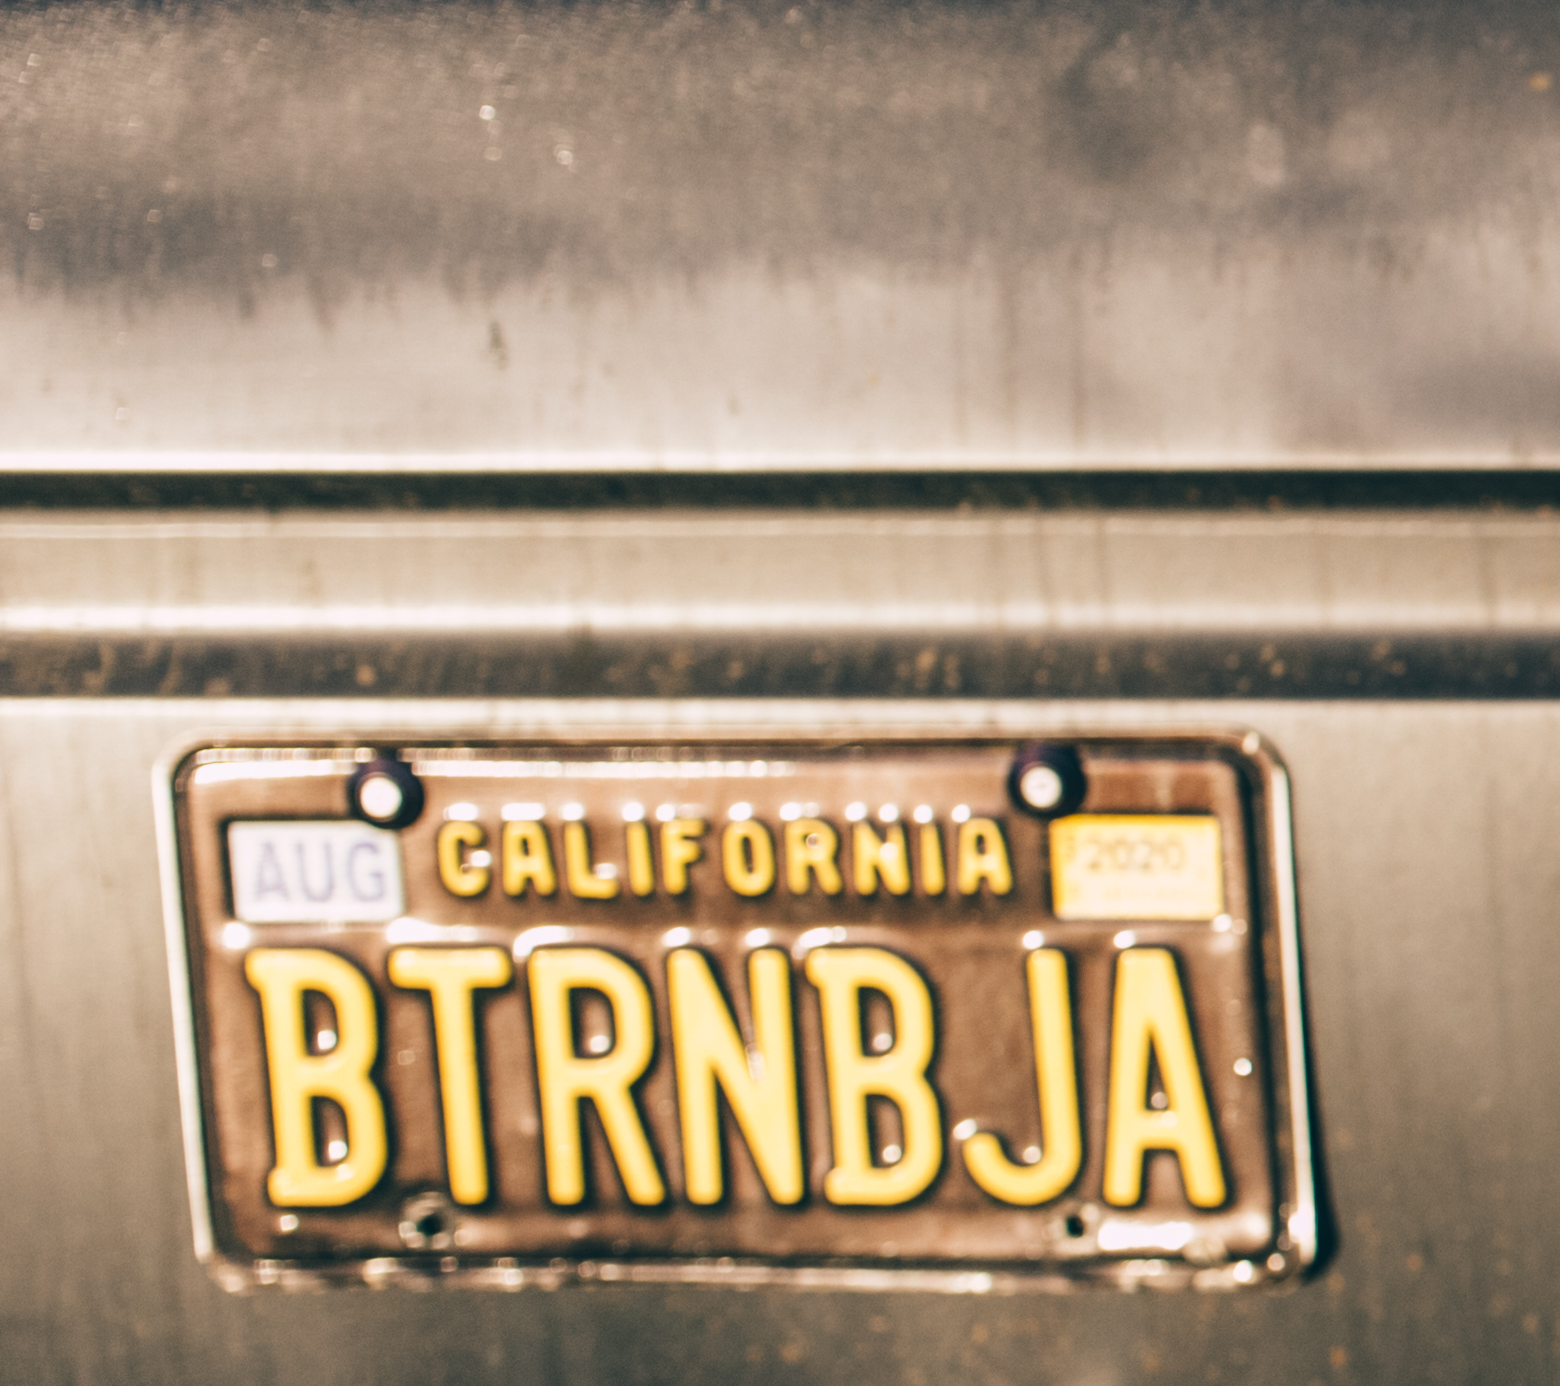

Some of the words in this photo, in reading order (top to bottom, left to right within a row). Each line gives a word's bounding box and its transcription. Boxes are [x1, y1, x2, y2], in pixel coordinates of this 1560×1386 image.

[252, 838, 388, 905] AUG
[436, 809, 1013, 898] CALIFORNIA
[1086, 834, 1186, 874] 2020
